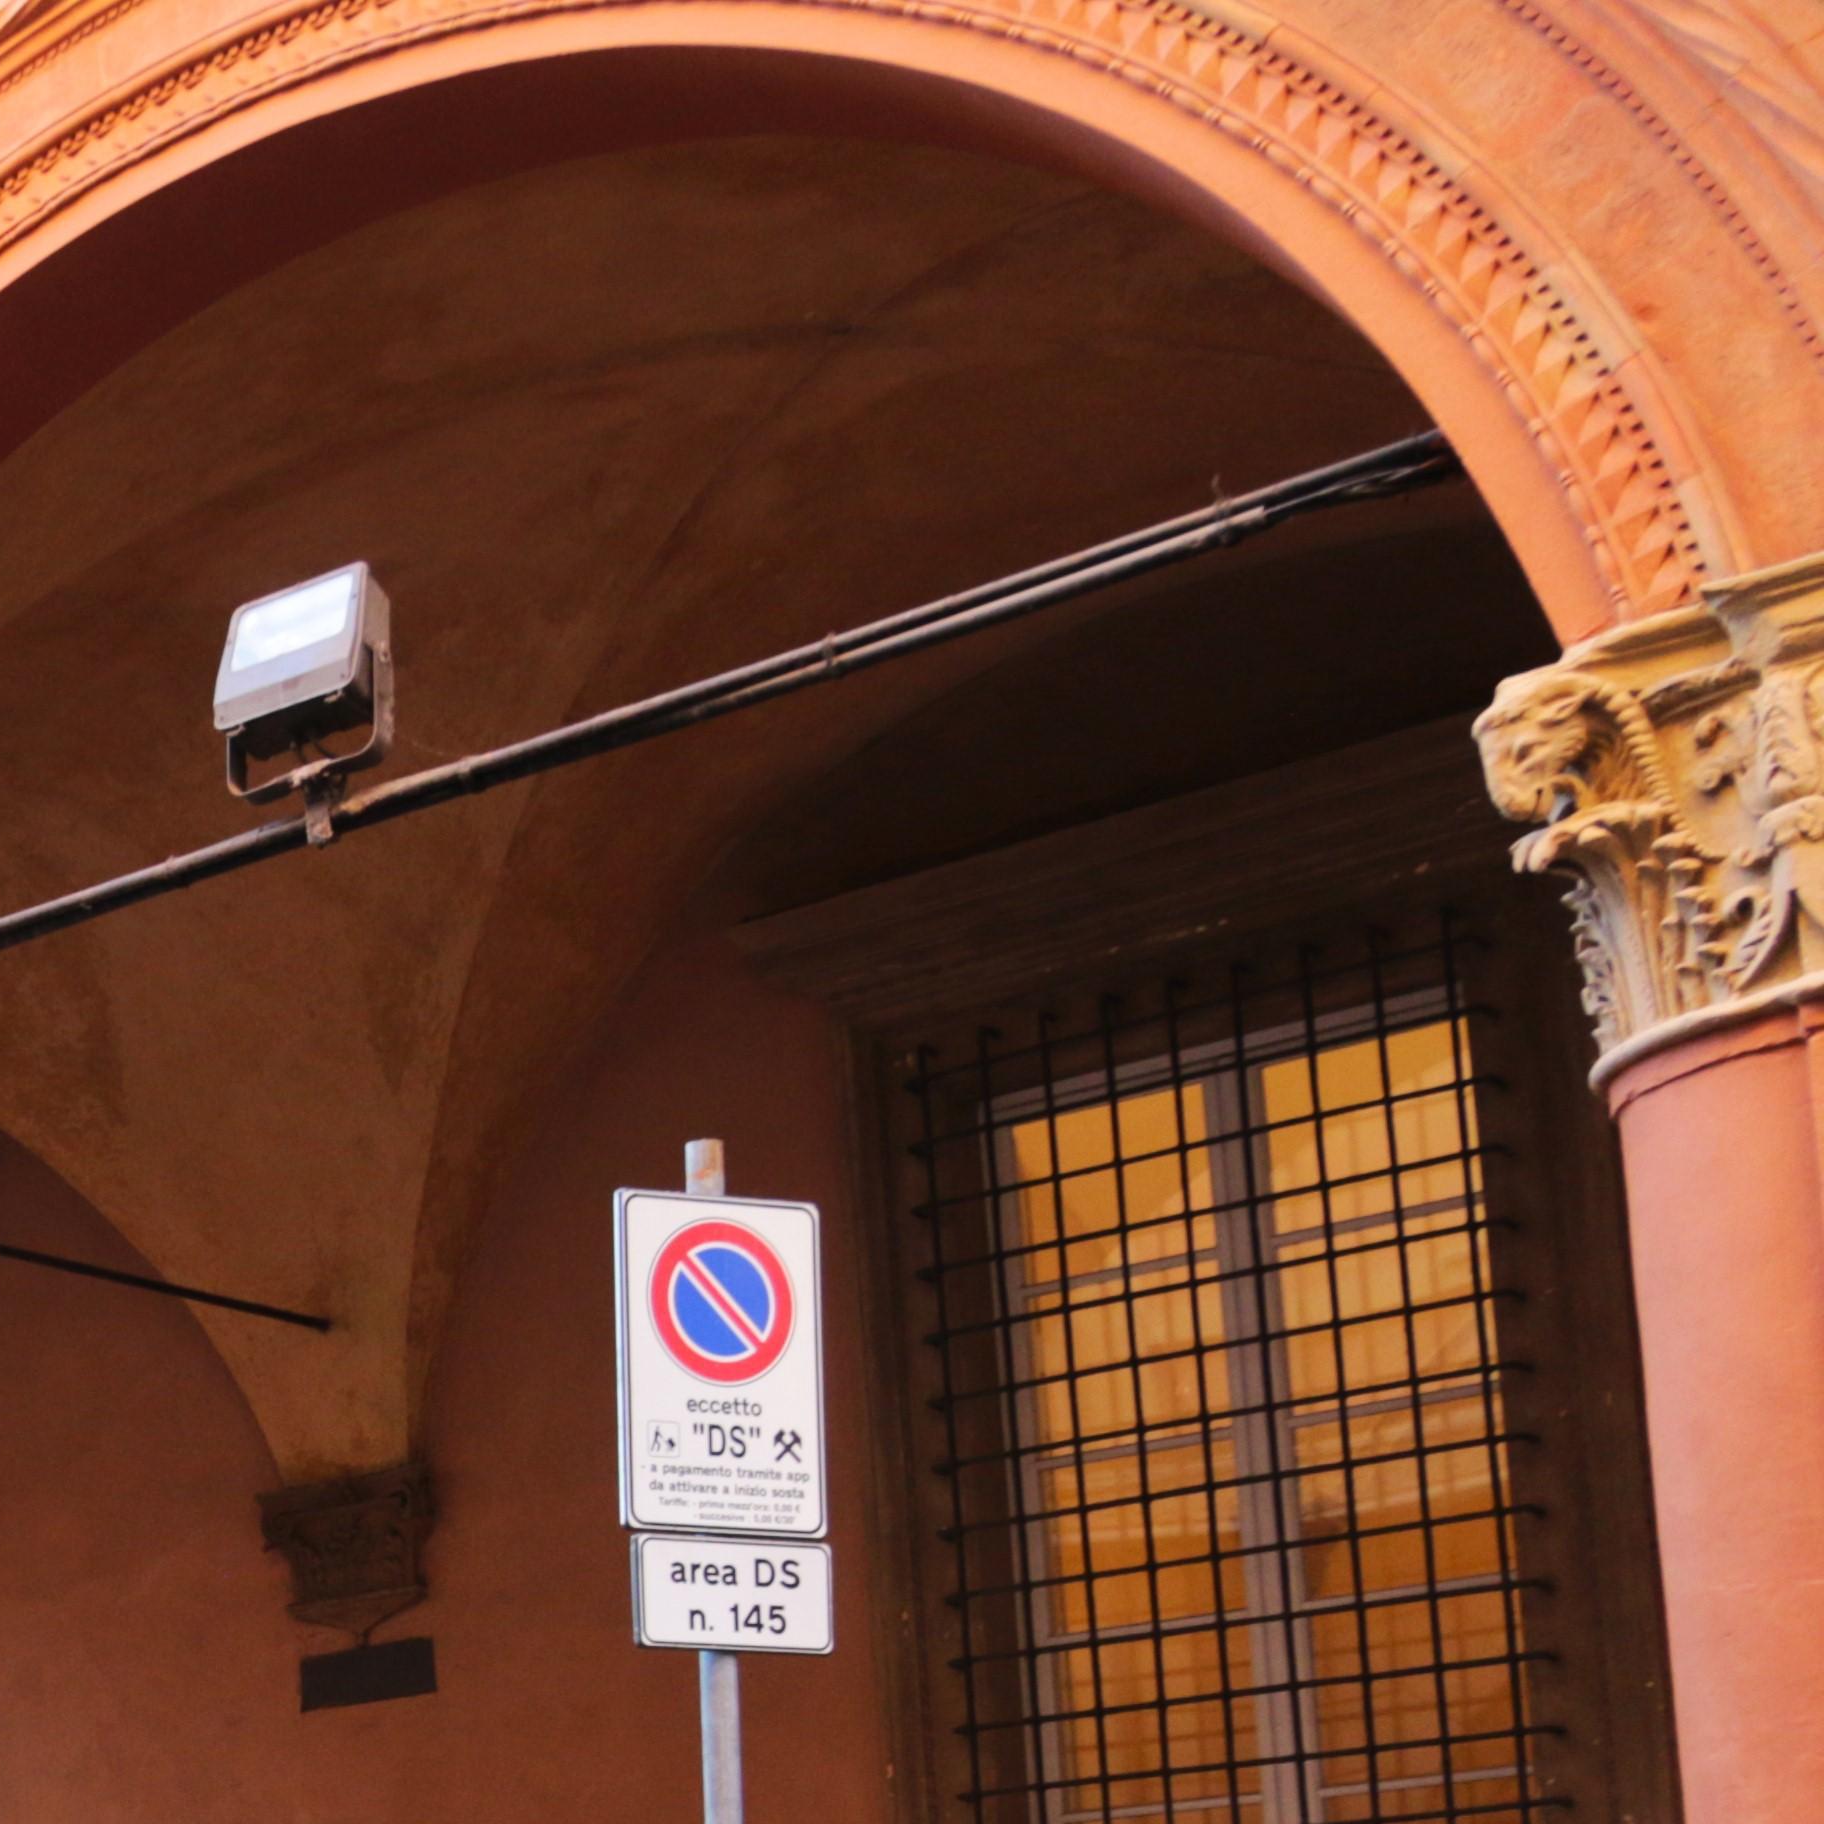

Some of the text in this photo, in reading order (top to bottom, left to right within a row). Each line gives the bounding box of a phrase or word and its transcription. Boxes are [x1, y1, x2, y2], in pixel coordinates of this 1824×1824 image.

[686, 1397, 763, 1417] eccetto
[693, 1422, 761, 1459] "DS"
[650, 1463, 658, 1473] a
[662, 1463, 732, 1479] pagamento
[736, 1465, 783, 1480] tramite
[786, 1471, 811, 1483] app
[649, 1479, 805, 1499] da attivare a inizio sosta
[670, 1558, 801, 1589] area DS
[689, 1603, 787, 1634] n. 145
